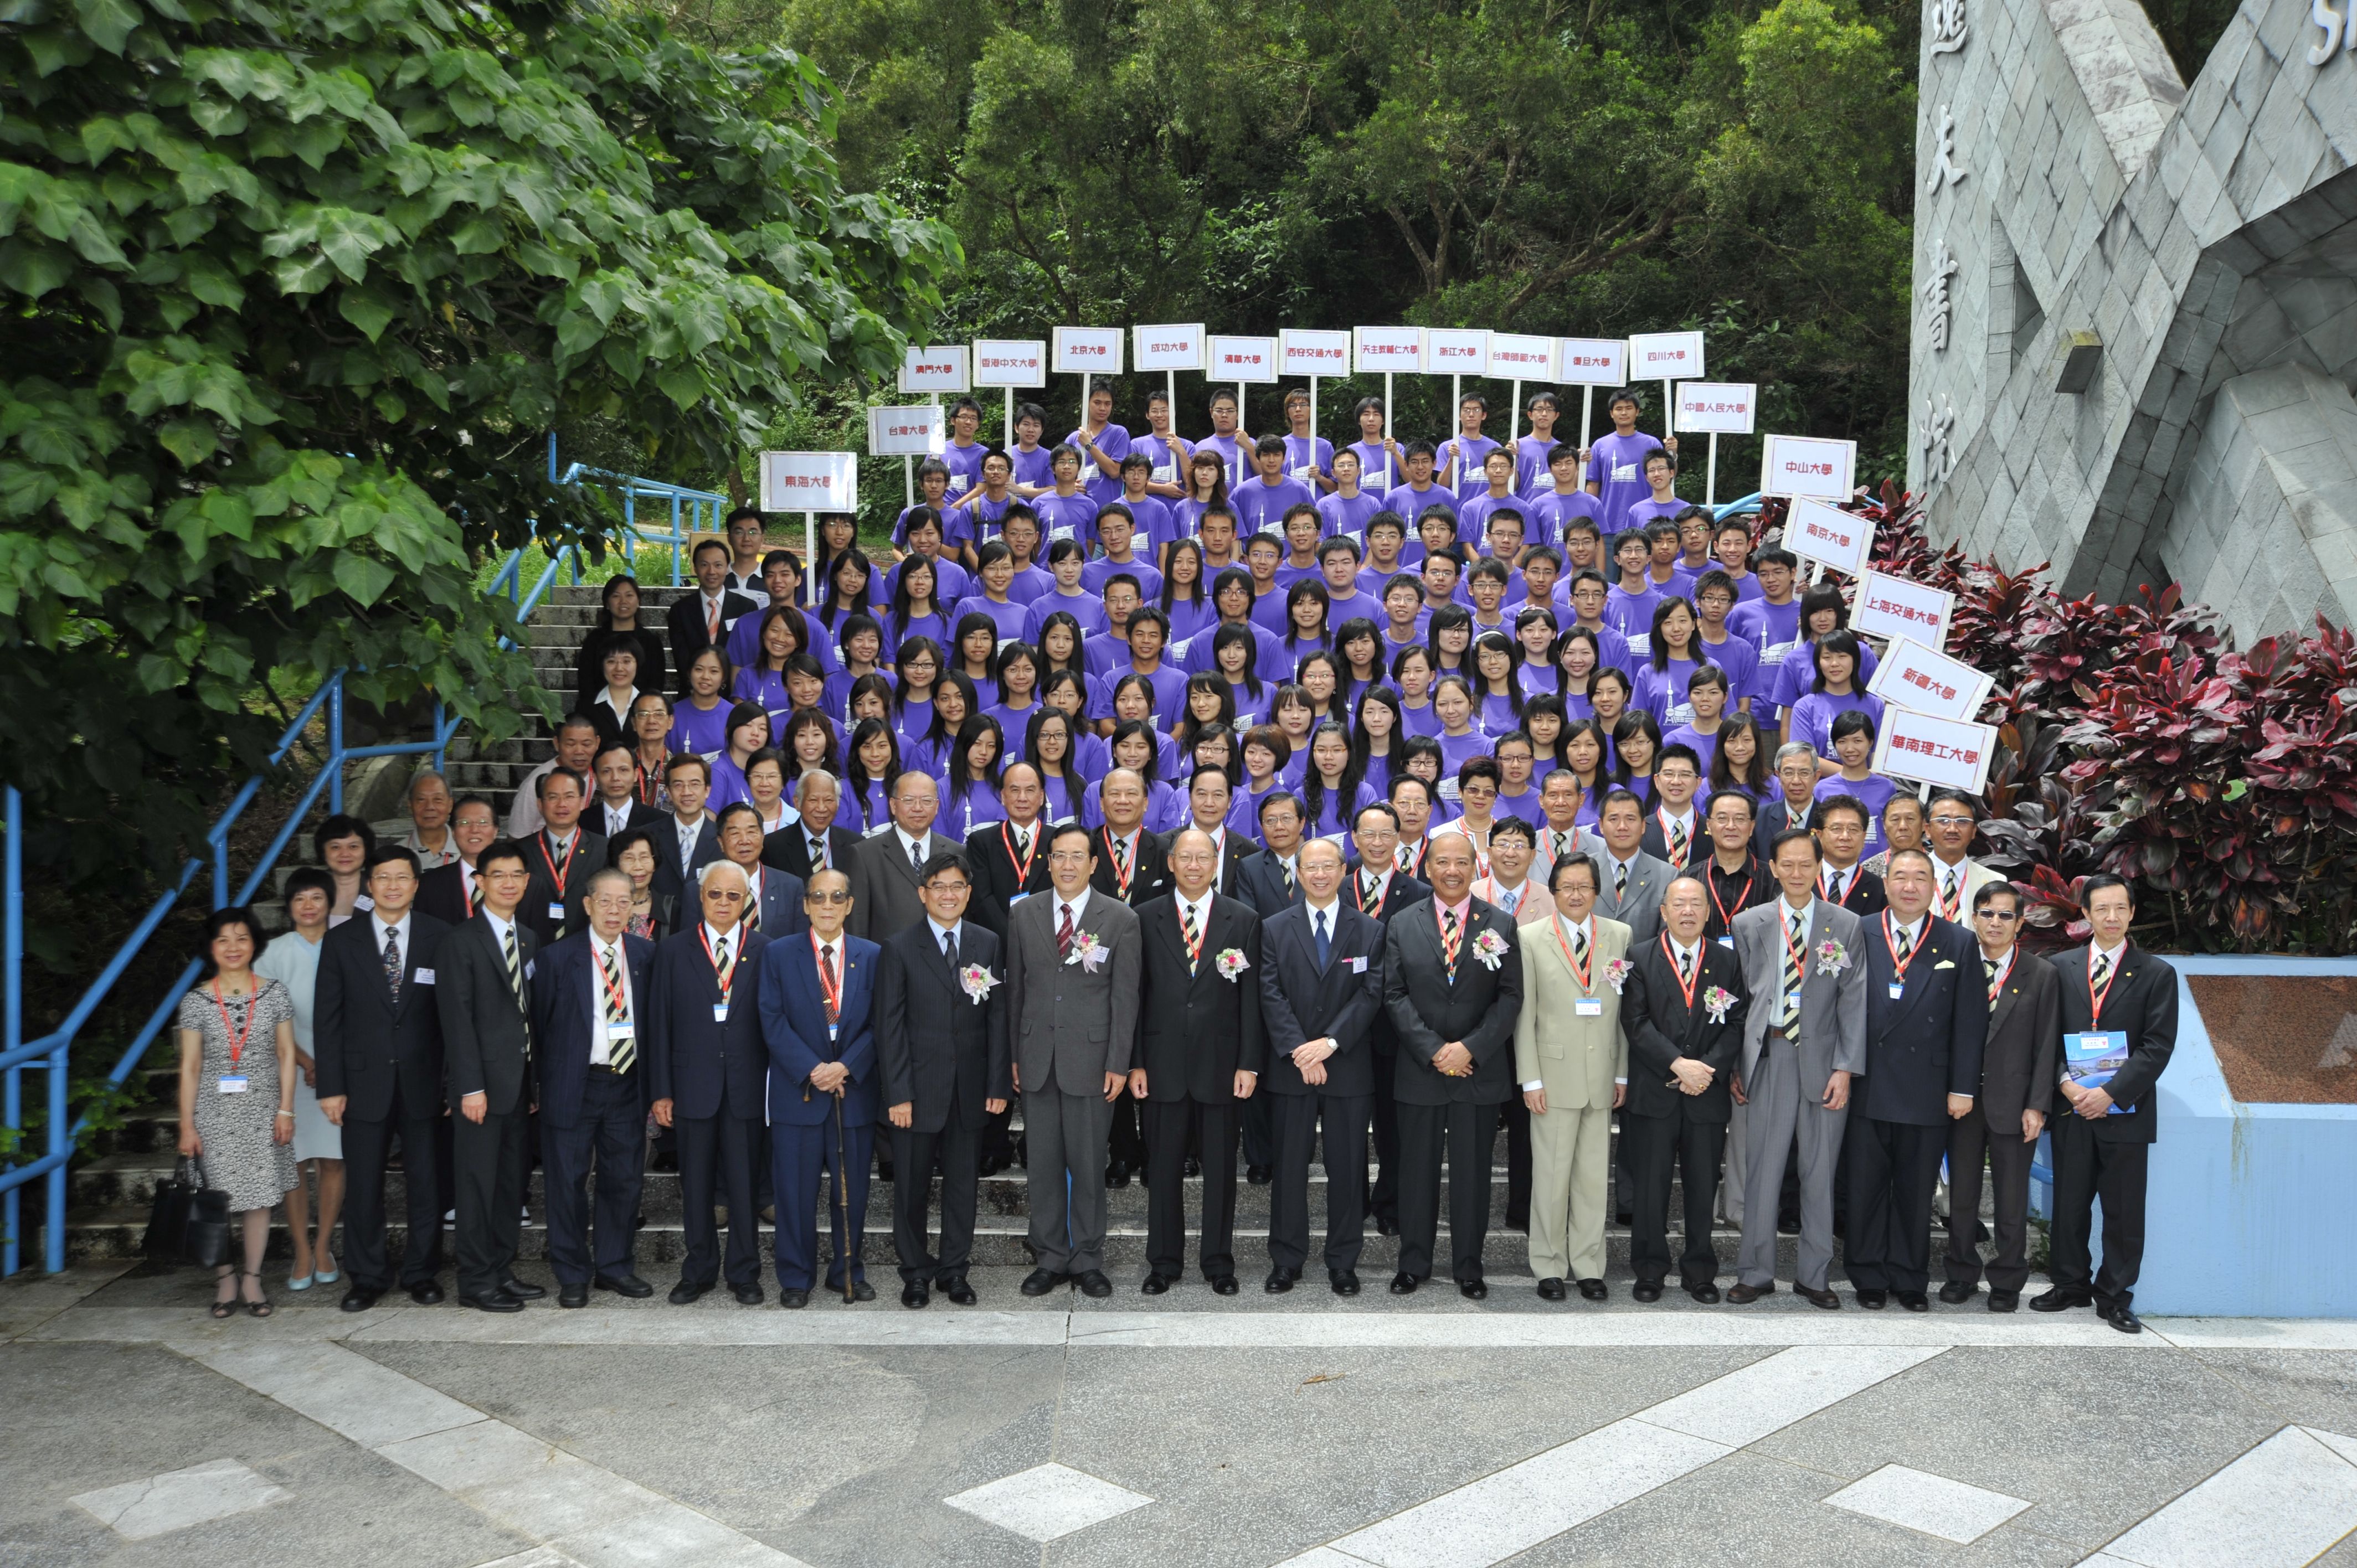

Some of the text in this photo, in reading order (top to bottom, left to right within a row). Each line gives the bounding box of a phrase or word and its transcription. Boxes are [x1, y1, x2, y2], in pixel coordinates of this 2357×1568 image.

[1070, 345, 1107, 355] 北京大學
[1151, 342, 1188, 353] 成功大學
[1288, 347, 1342, 359] 西安交通大學
[1439, 347, 1476, 357] 浙江大學
[1224, 354, 1261, 364] 清華大學
[1648, 350, 1686, 362] 四川大學
[982, 358, 1037, 368] 香港中文大學
[1573, 357, 1610, 368] 復旦大學
[915, 364, 953, 374] 澳門大學
[1685, 403, 1746, 414] 中國人民大學
[889, 425, 928, 436] 台灣大學
[1785, 461, 1833, 476] 中山大學
[1806, 523, 1851, 548] 南京大學
[1866, 596, 1939, 626] 上海交通大學
[1902, 667, 1957, 700] 新疆大學
[1891, 734, 1979, 765] 華南理工大學
